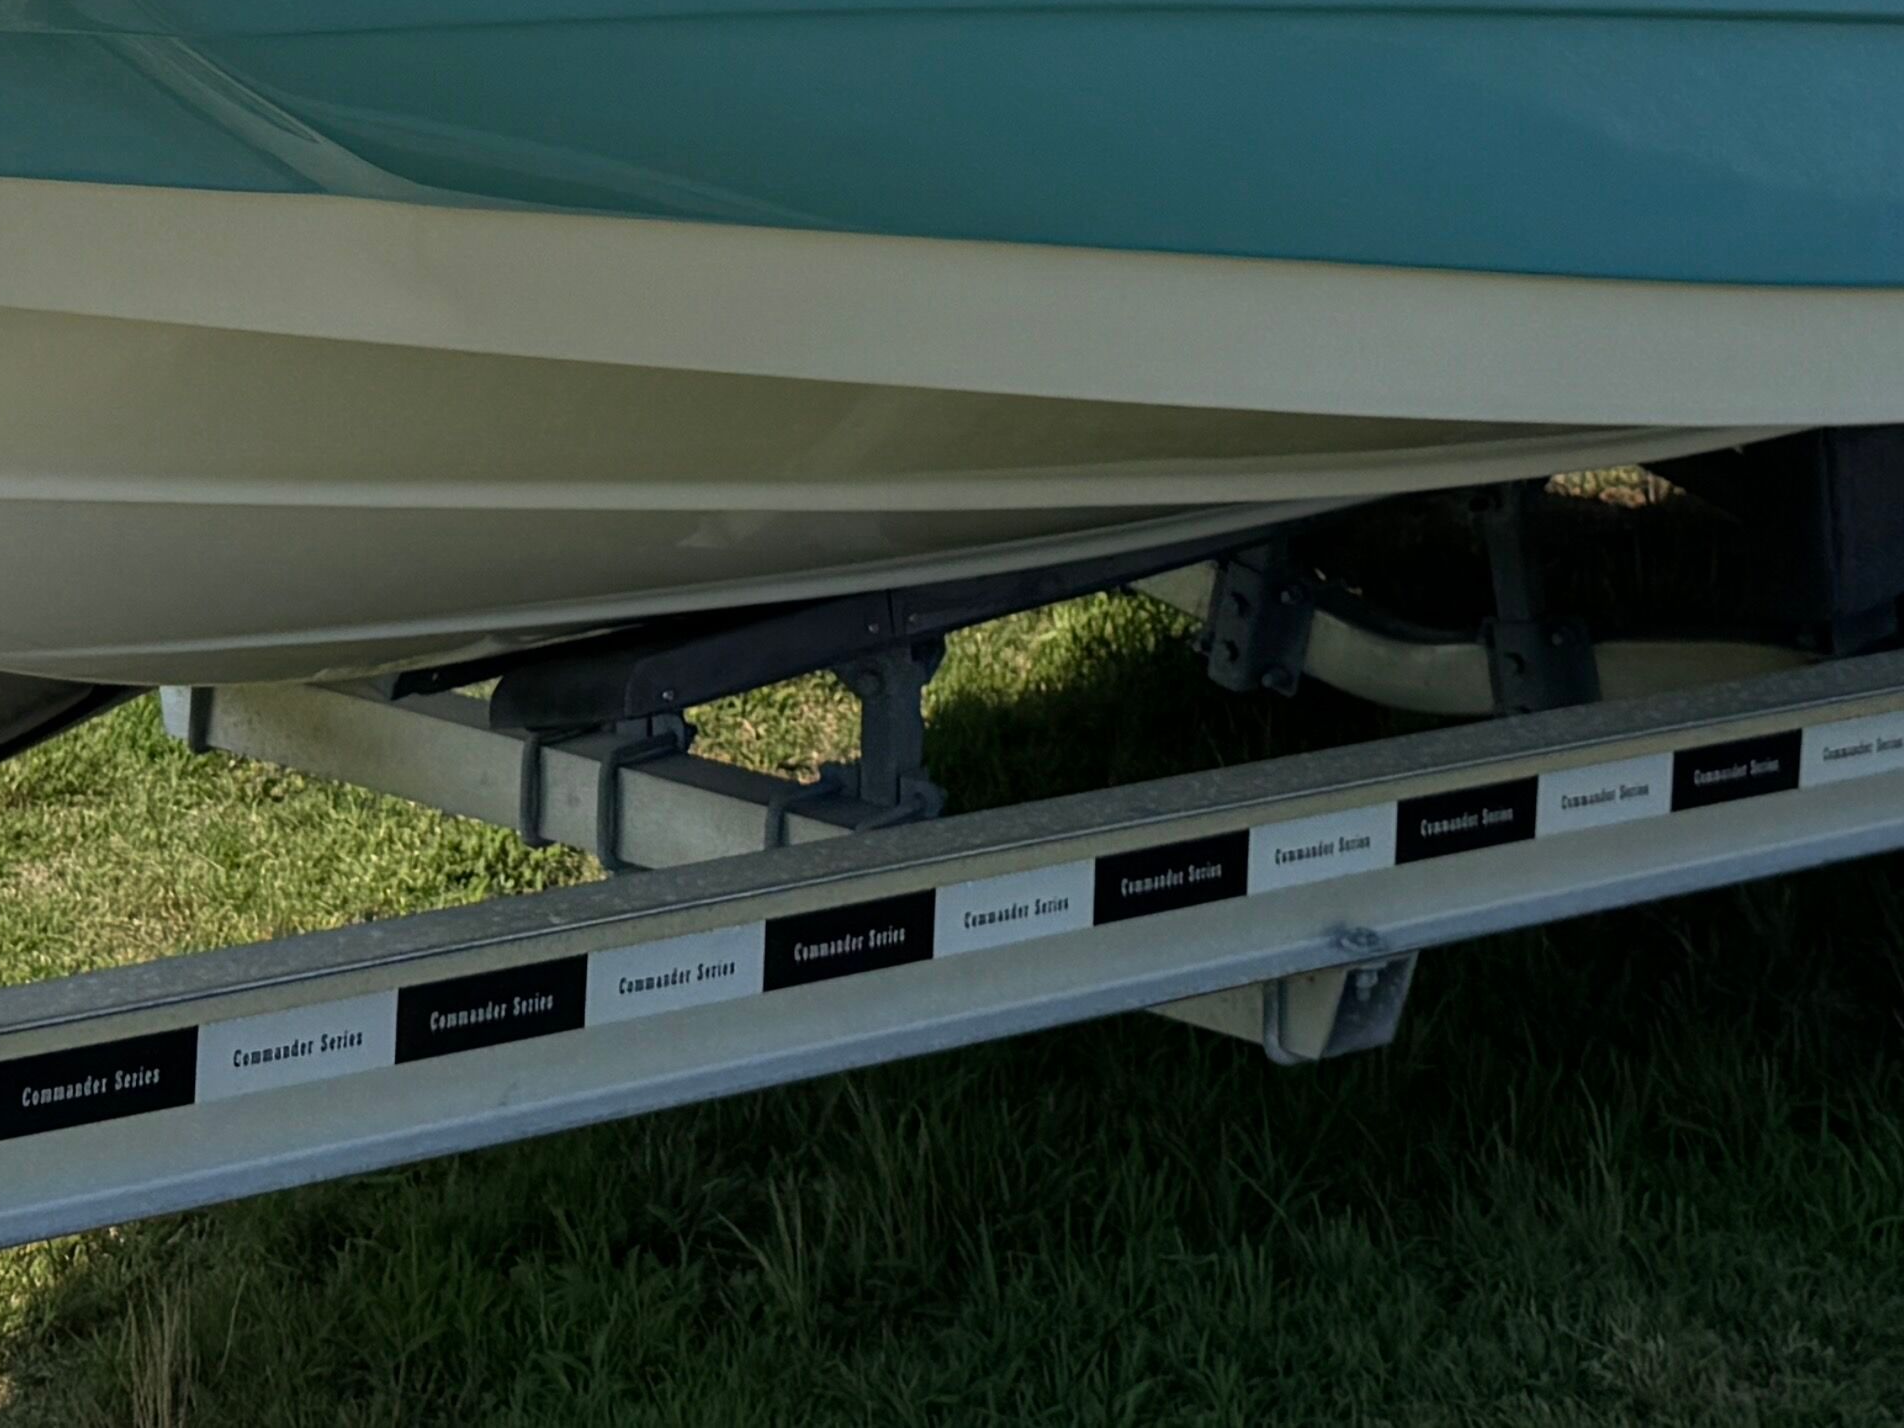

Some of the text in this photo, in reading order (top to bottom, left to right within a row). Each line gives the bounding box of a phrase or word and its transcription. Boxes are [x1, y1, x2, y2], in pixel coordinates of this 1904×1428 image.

[1121, 864, 1221, 896] Commander Series
[965, 898, 1068, 928] Commander Series
[794, 927, 904, 961] Commander Series
[619, 963, 734, 994] Commander Series
[430, 994, 552, 1030] Commander Series
[234, 1032, 362, 1067] Commander Series
[22, 1067, 159, 1106] Commander Series
